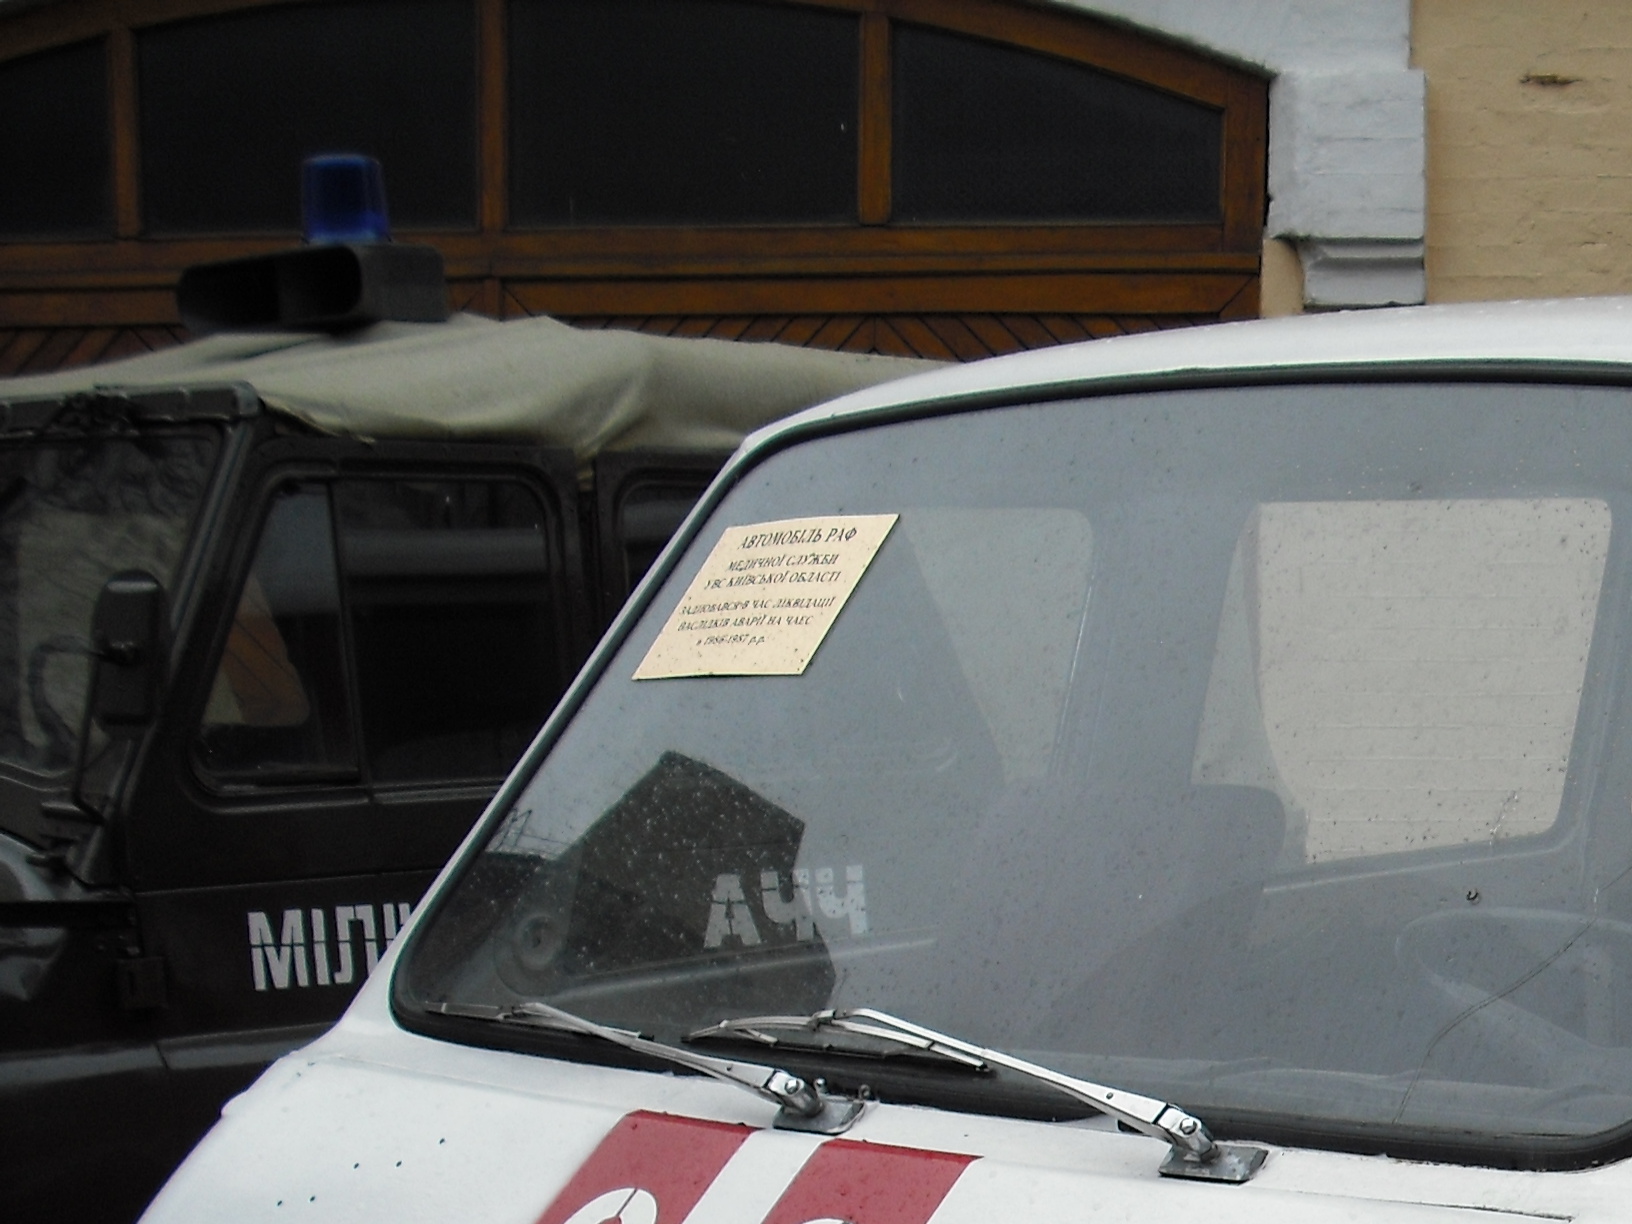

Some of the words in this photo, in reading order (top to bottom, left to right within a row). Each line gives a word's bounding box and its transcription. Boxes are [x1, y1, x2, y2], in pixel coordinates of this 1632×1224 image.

[739, 529, 822, 549] АВТОМОБІЛЬ
[825, 527, 857, 542] РАФ
[786, 553, 839, 566] СЛУЖБИ
[789, 571, 841, 583] ОБЛАСТІ
[753, 600, 771, 608] ЧАС
[767, 616, 781, 625] НА
[786, 616, 813, 625] ЧАЕС
[248, 903, 411, 991] МІЛІ
